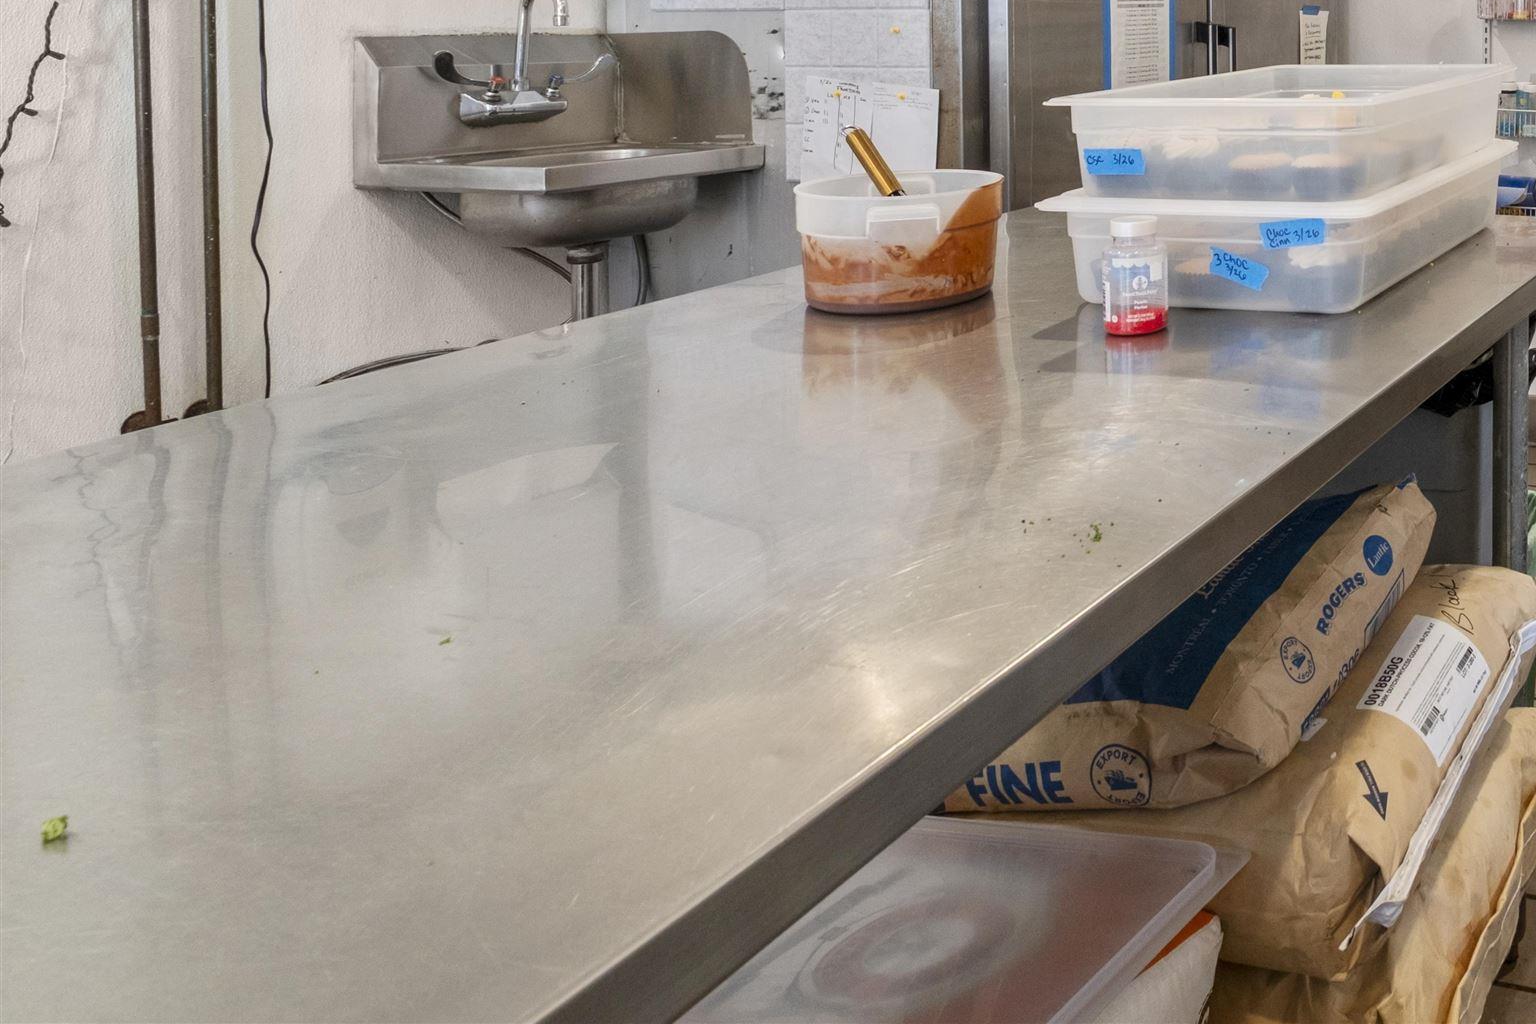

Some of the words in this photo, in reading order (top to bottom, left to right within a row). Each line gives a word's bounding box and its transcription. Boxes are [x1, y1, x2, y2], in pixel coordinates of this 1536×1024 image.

[1113, 153, 1136, 166] 3/26
[1293, 228, 1320, 242] 3/26
[1213, 252, 1223, 266] 3
[1368, 542, 1390, 570] Lantic
[1315, 571, 1367, 636] ROGERS
[1364, 655, 1404, 707] 0018B50G
[1096, 749, 1137, 770] EXPORT
[965, 759, 1074, 808] FINE
